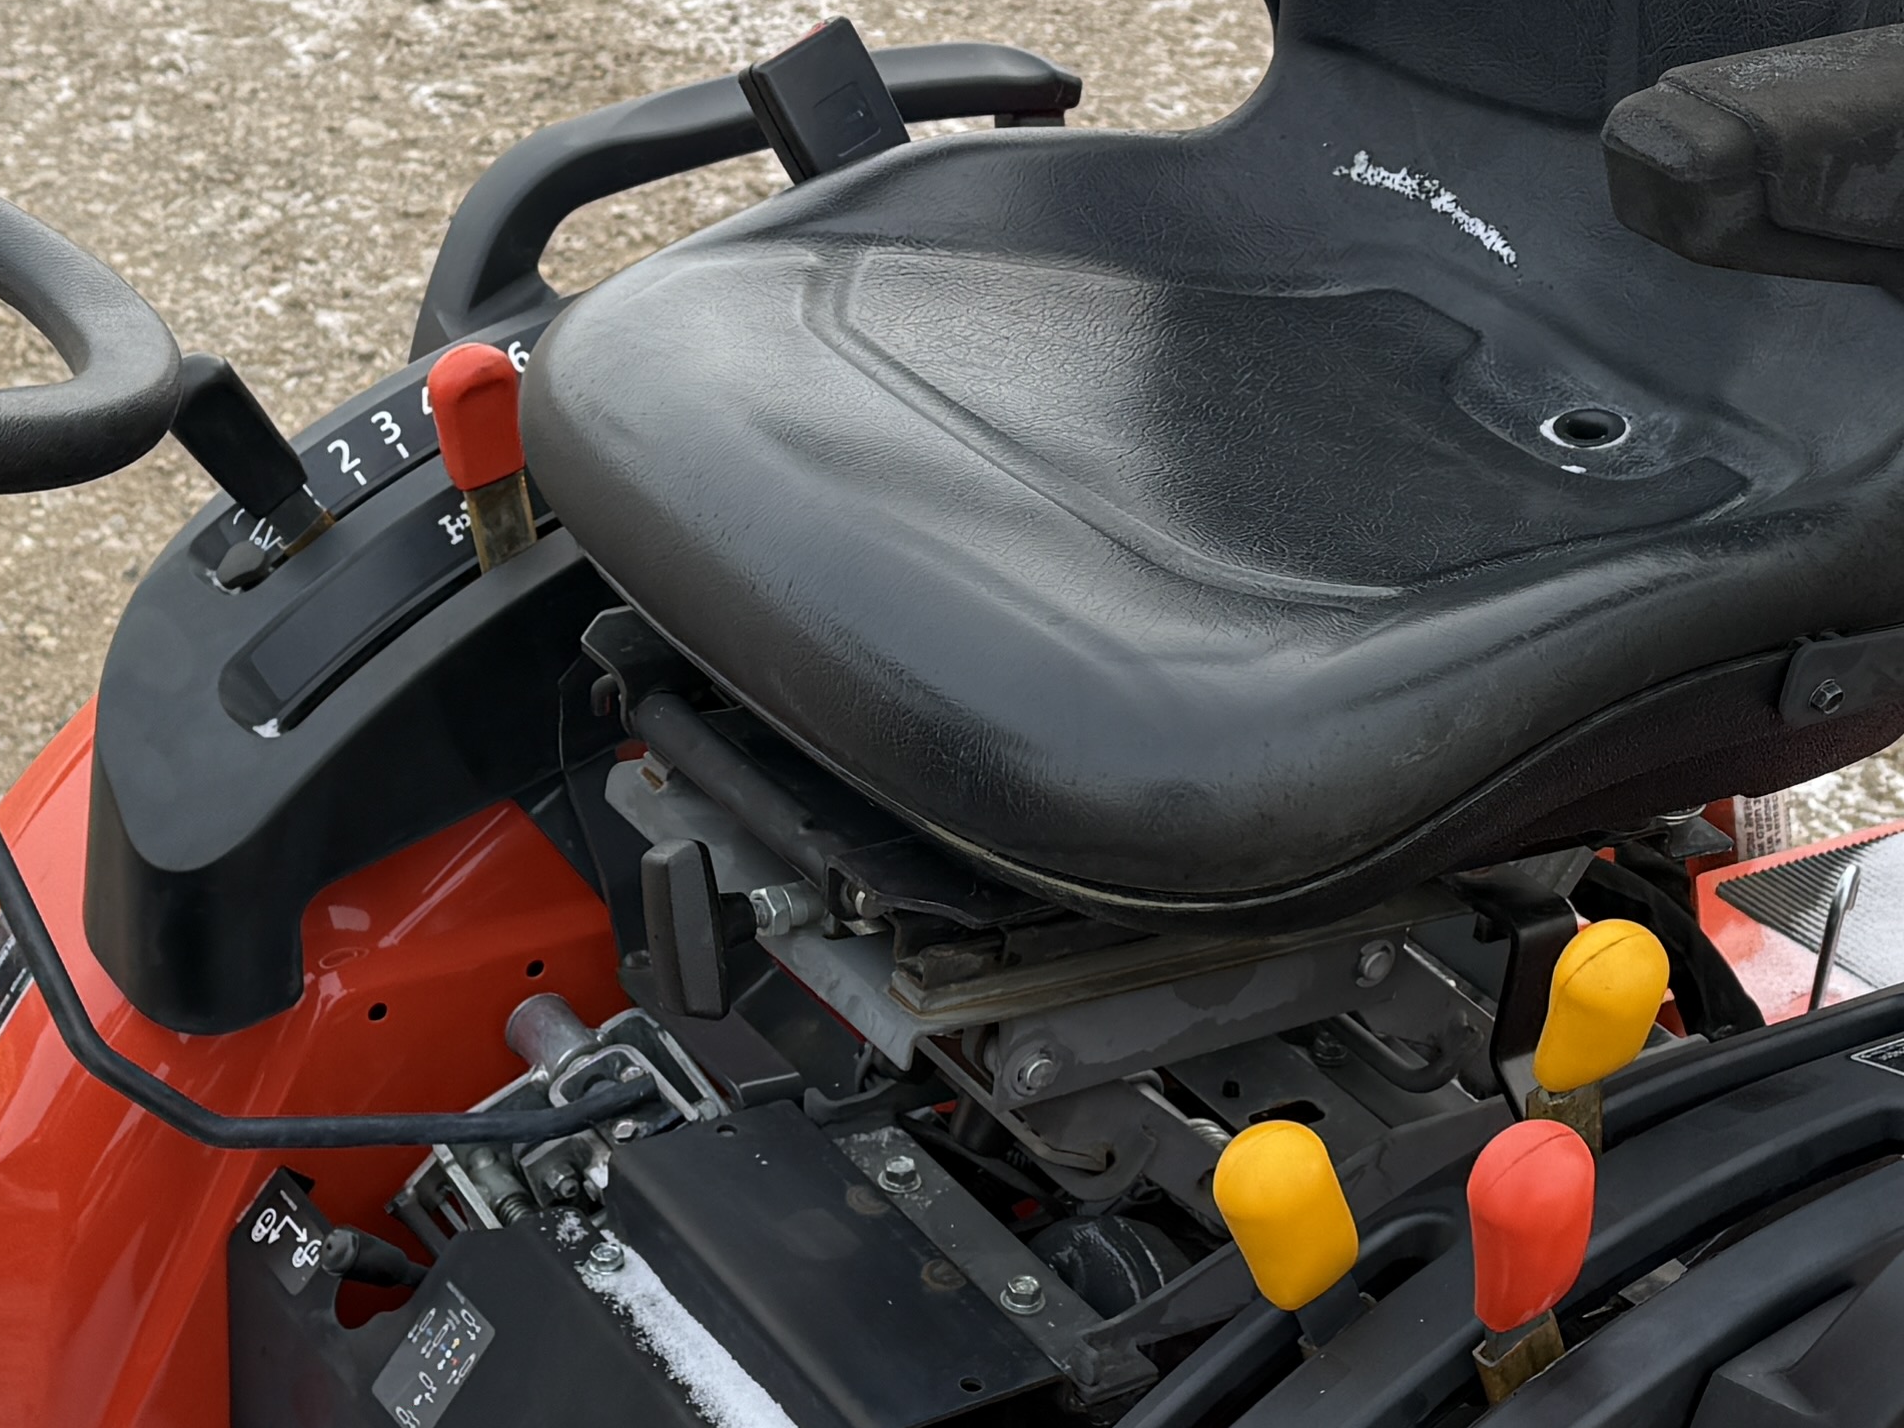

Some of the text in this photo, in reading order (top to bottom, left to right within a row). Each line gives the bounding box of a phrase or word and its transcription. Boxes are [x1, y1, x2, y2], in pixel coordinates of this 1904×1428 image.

[507, 340, 531, 373] 6
[370, 410, 402, 445] 3
[327, 438, 361, 474] 2
